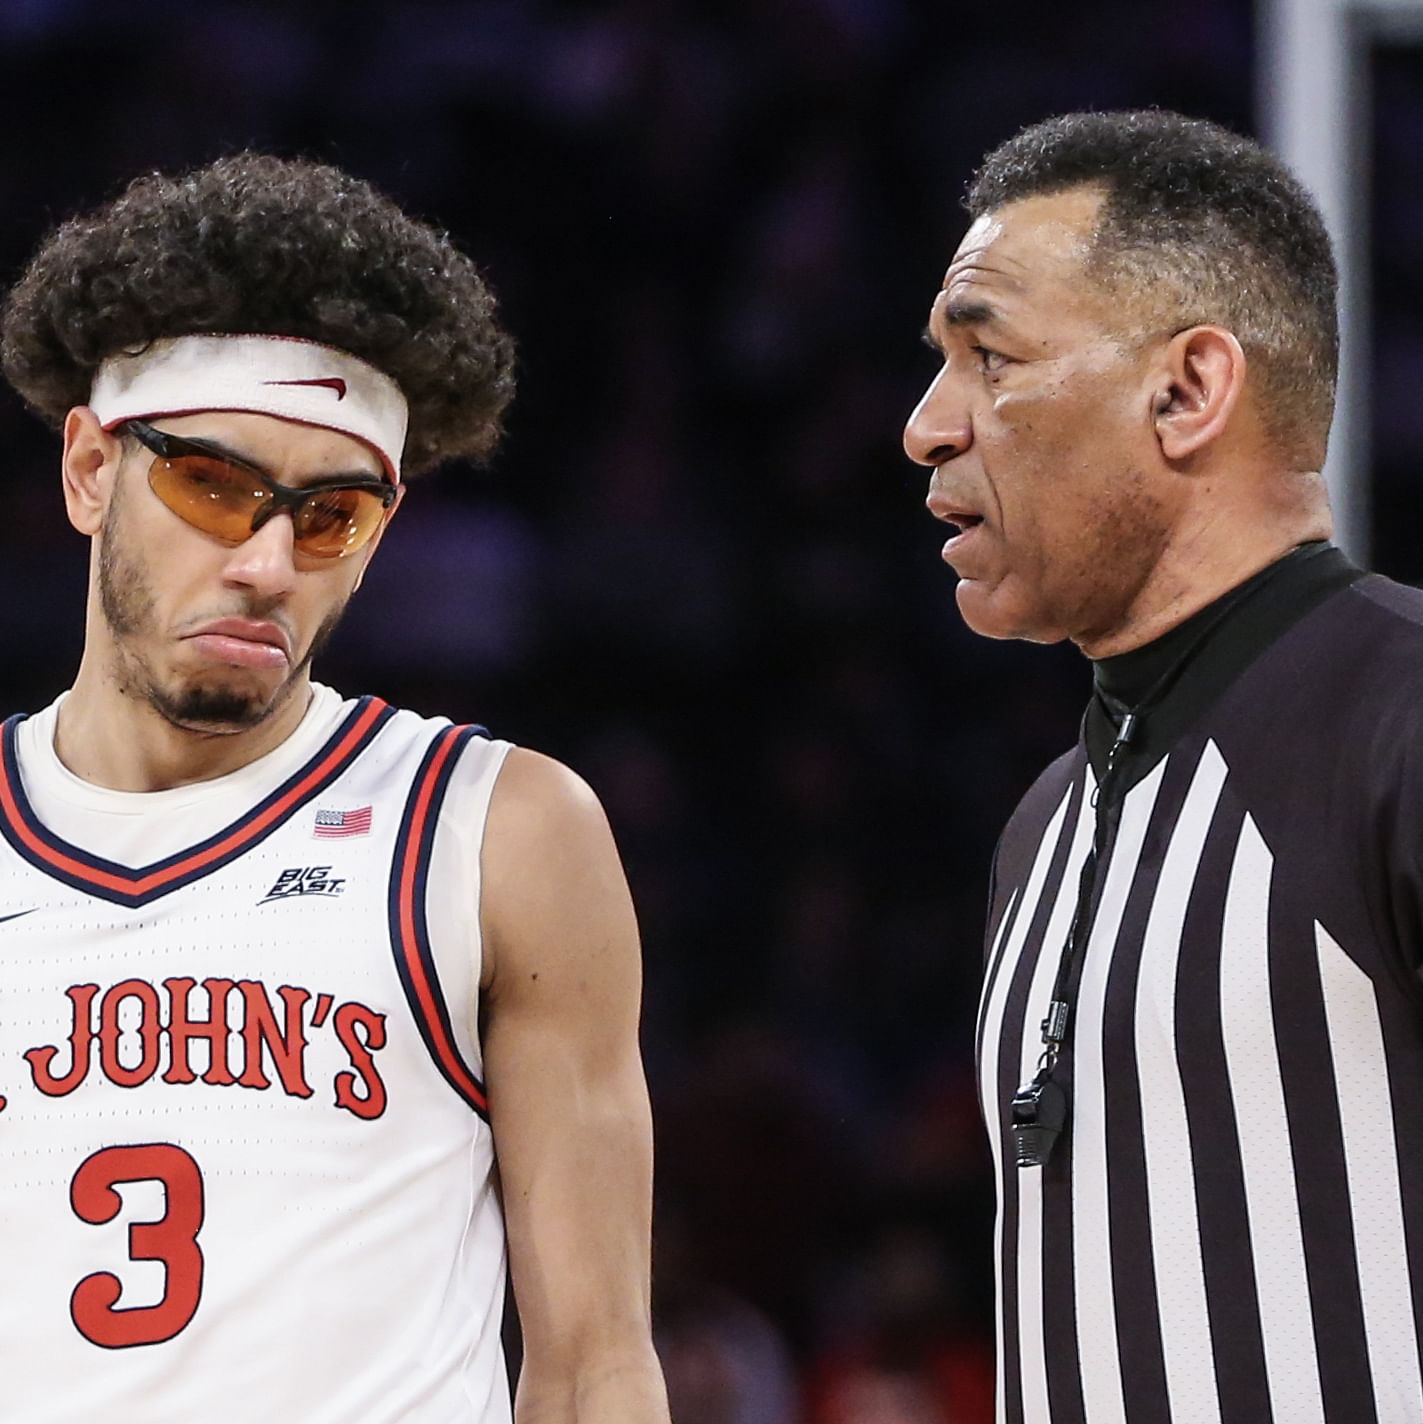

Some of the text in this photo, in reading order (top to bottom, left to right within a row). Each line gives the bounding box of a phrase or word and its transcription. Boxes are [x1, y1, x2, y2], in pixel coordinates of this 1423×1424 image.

[265, 879, 346, 898] EAST
[276, 865, 334, 884] BIG
[23, 975, 388, 1121] JOHN'S
[69, 1142, 205, 1350] 3
